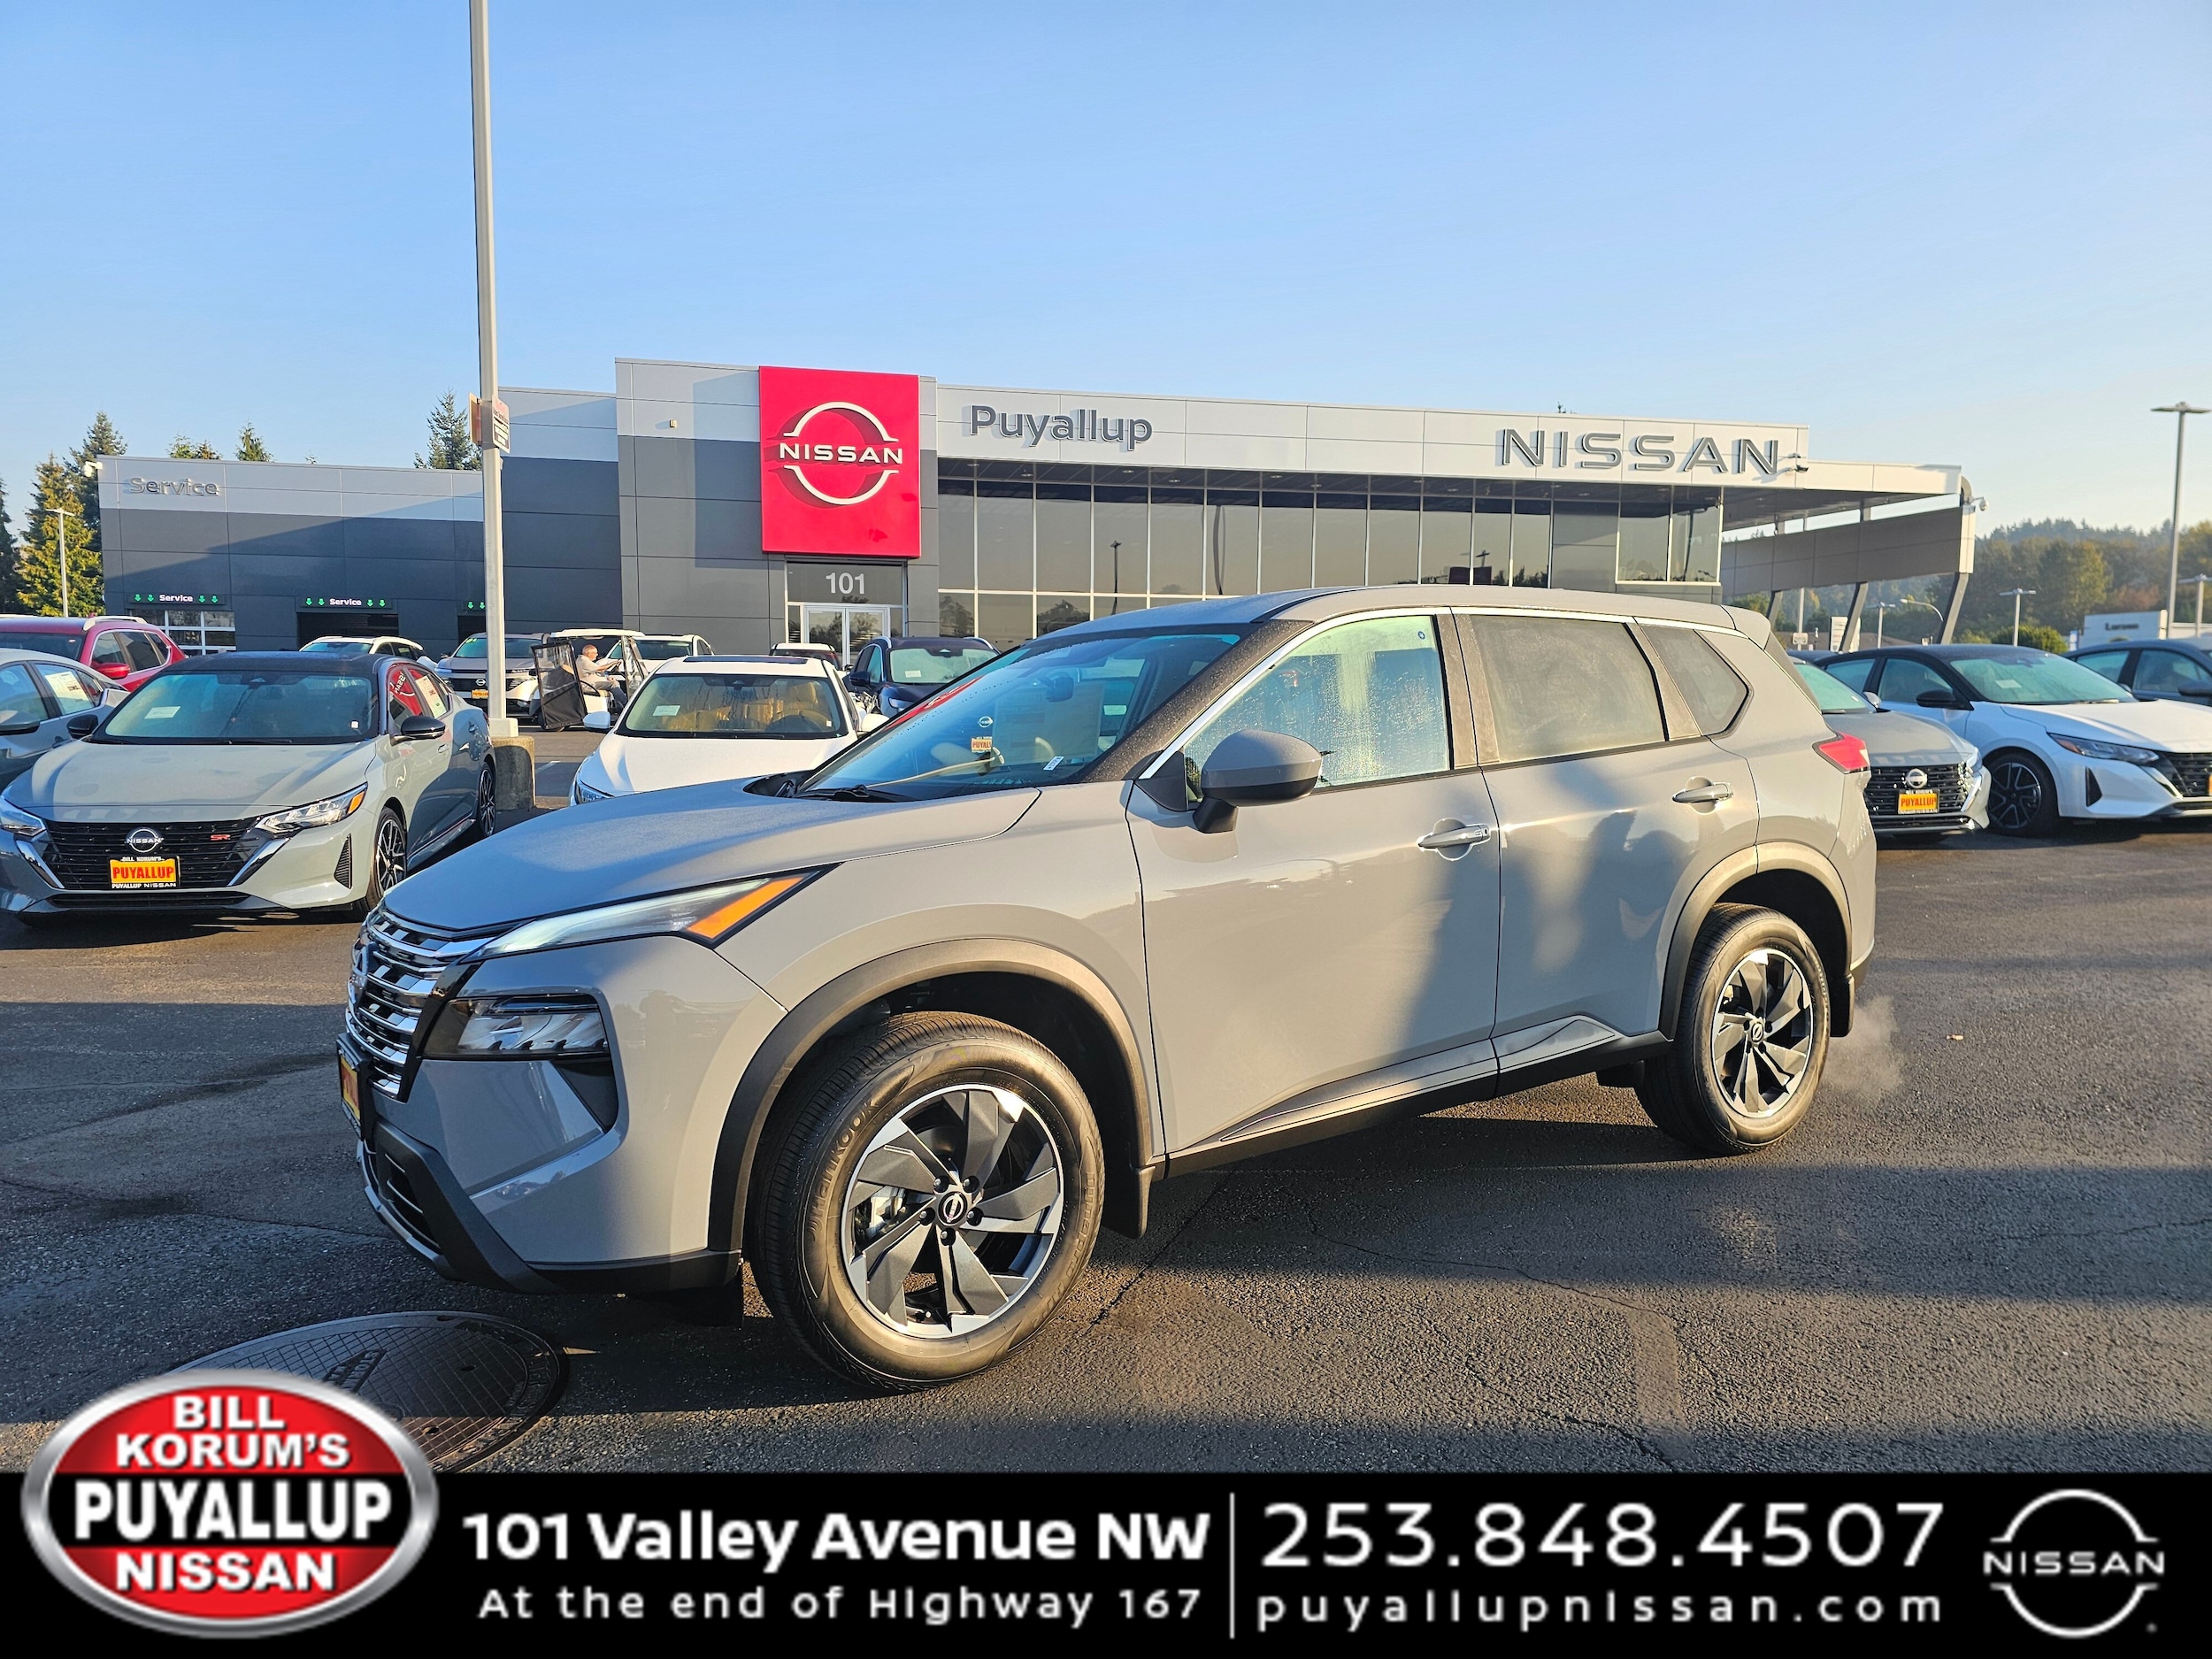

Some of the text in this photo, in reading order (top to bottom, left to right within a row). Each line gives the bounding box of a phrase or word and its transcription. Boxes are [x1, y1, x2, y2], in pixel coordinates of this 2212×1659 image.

[971, 405, 1153, 451] Puyallup
[780, 442, 902, 465] NISSAN
[1502, 428, 1779, 475] NISSAN
[128, 477, 219, 496] Service
[826, 572, 865, 595] 101
[159, 594, 194, 603] Service
[1901, 796, 1937, 807] PUYALLUP
[112, 866, 174, 879] PUYALLUP
